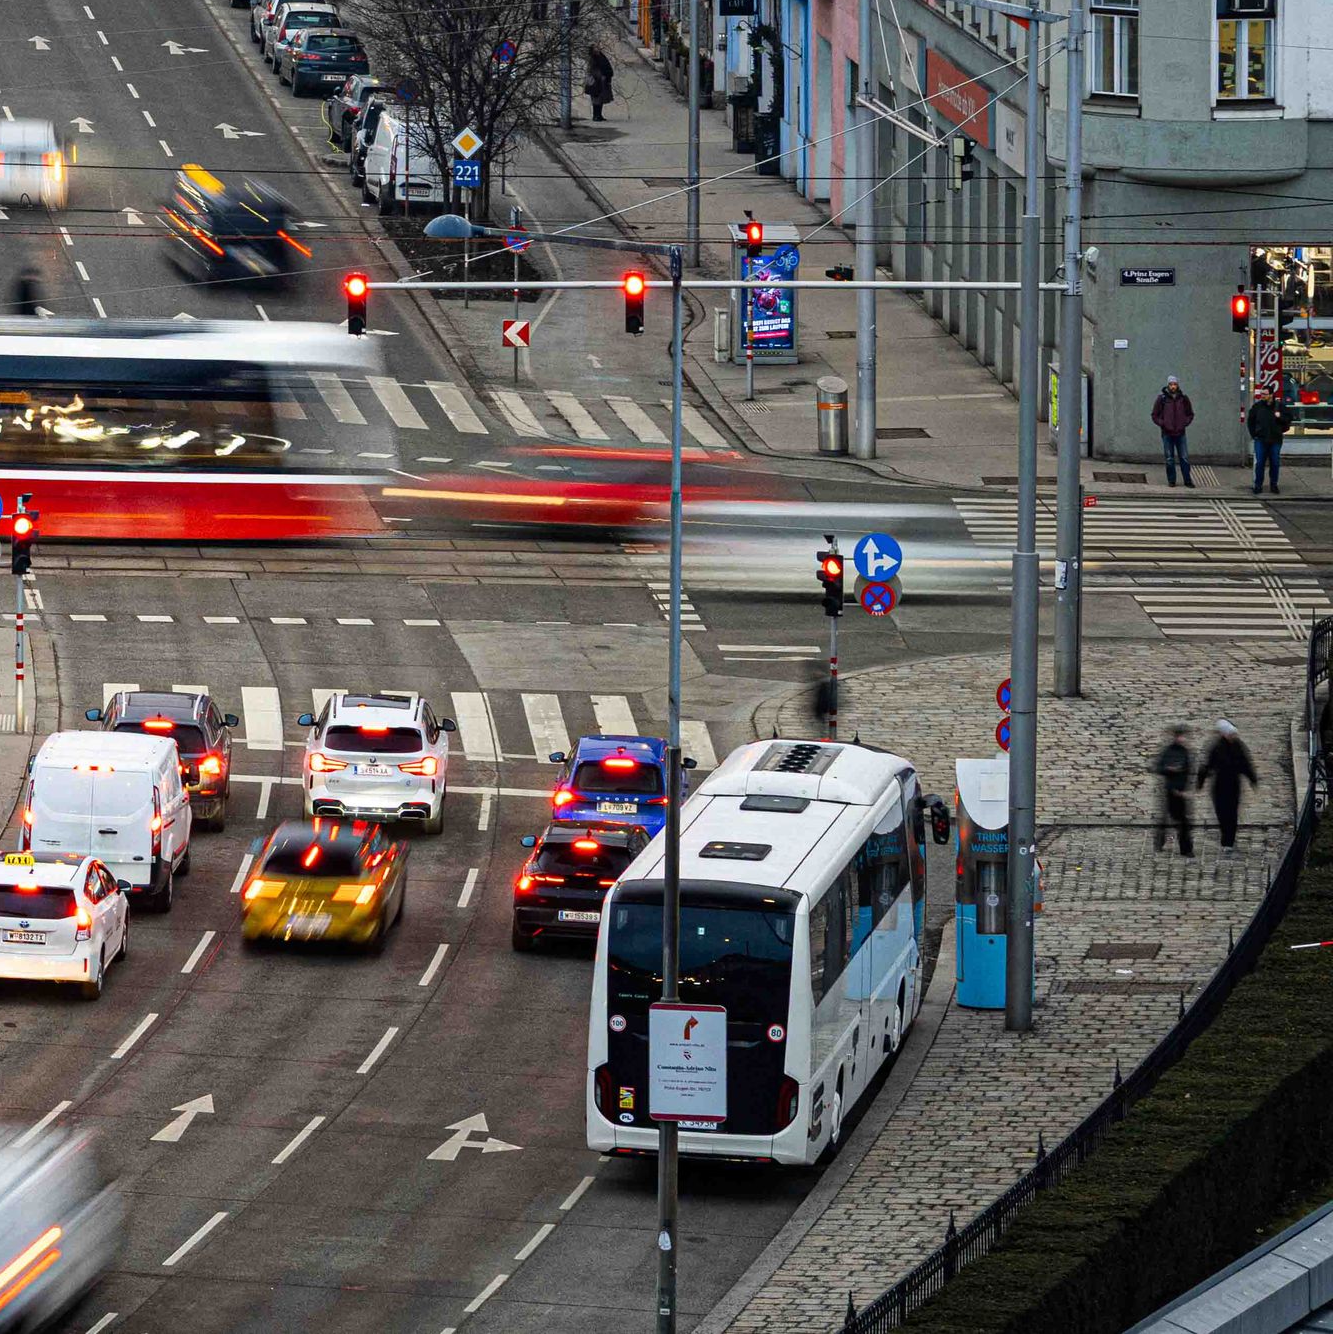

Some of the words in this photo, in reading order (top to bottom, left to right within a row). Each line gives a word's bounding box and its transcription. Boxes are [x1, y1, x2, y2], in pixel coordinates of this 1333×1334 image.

[976, 832, 1007, 842] TRINK
[612, 1019, 623, 1027] 100
[770, 1028, 782, 1037] 80
